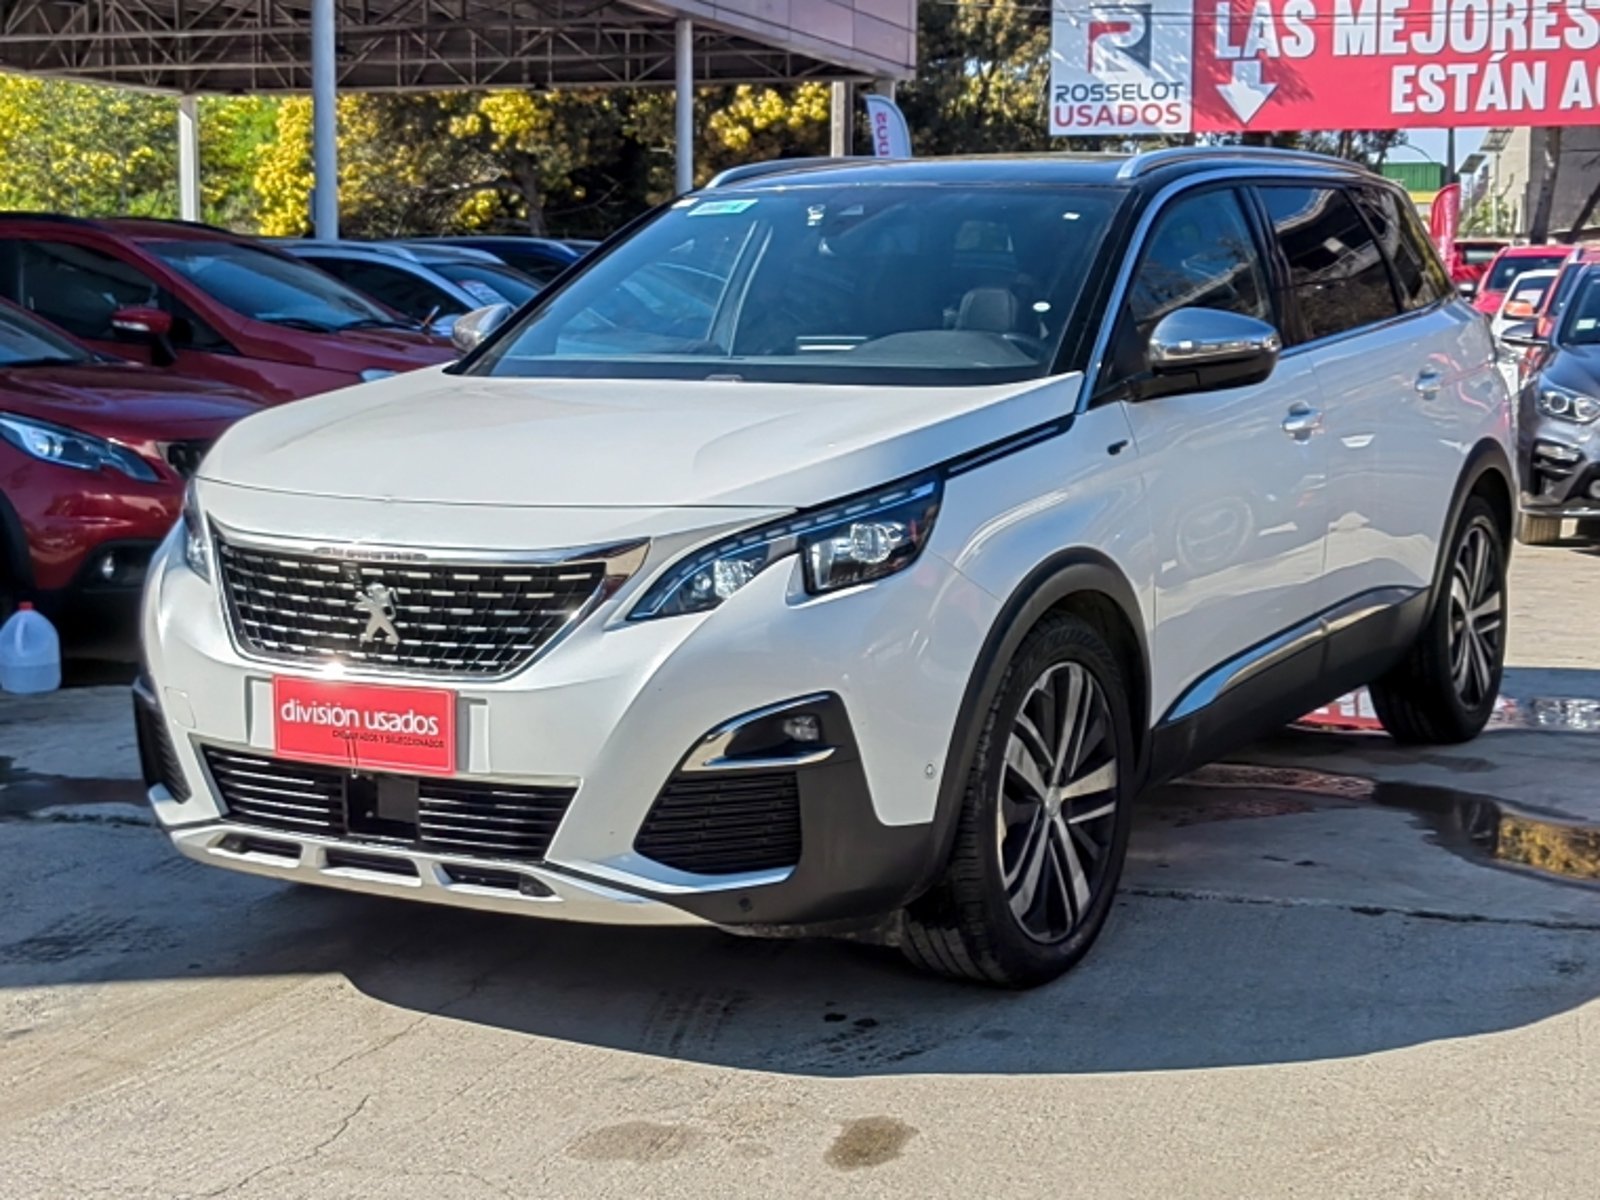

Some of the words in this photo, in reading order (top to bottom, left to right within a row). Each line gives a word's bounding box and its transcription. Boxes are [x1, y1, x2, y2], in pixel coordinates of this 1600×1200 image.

[1215, 0, 1317, 59] LAS
[1332, 0, 1600, 56] MEJORES
[1055, 81, 1183, 103] ROSSELOT
[1391, 52, 1547, 114] ESTÁN
[1559, 60, 1600, 110] A
[1055, 102, 1182, 127] USADOS
[281, 699, 359, 728] división
[364, 709, 439, 736] usados
